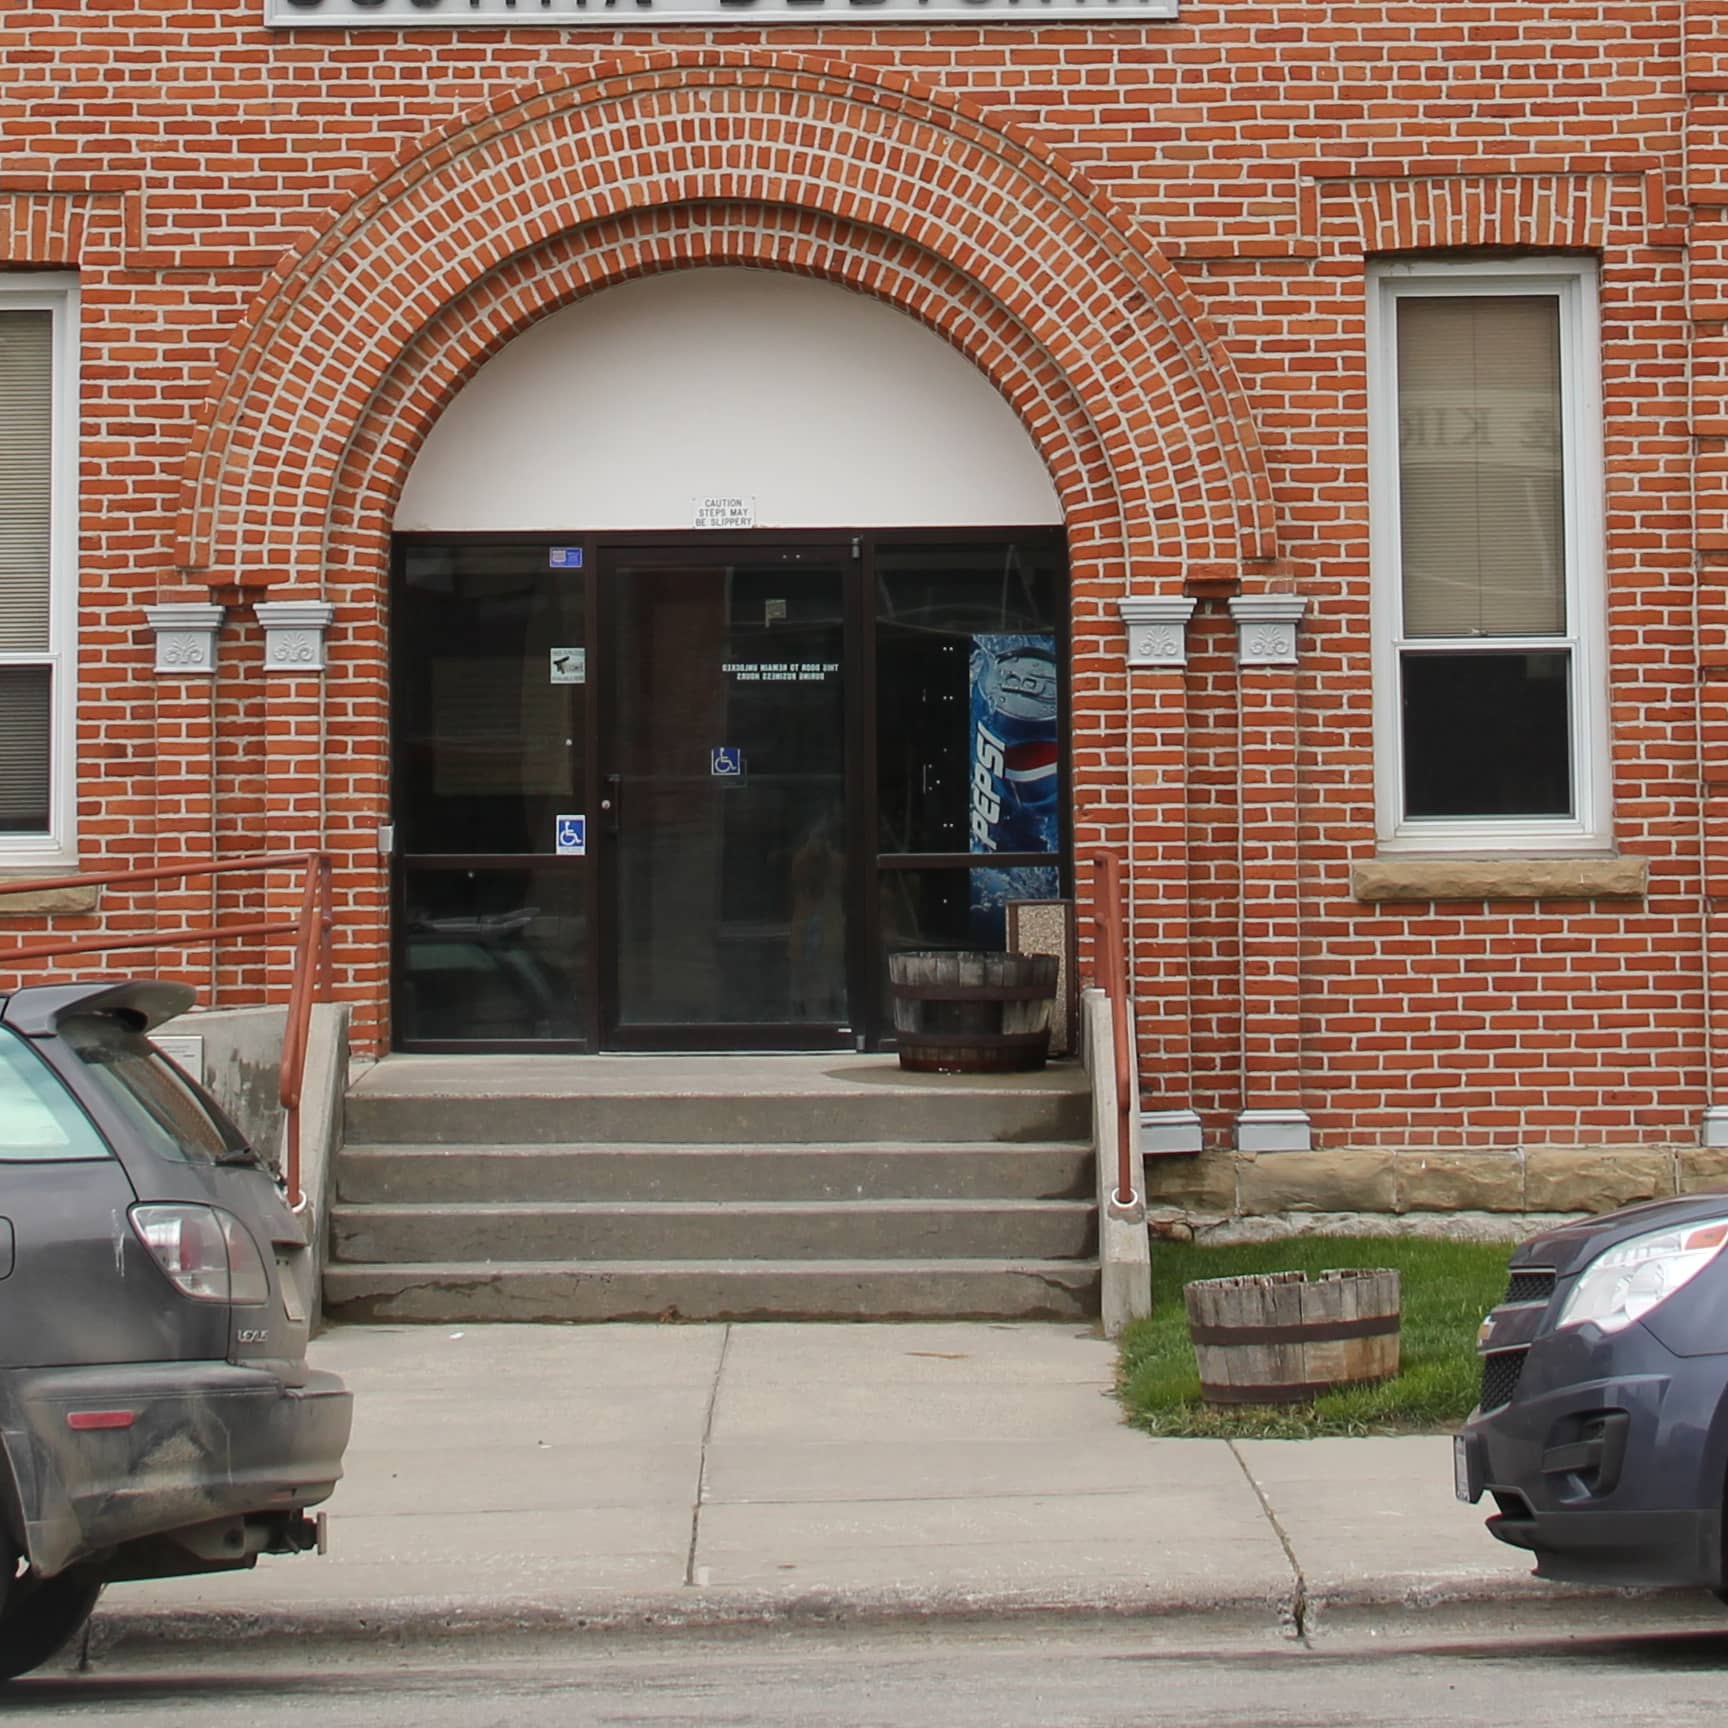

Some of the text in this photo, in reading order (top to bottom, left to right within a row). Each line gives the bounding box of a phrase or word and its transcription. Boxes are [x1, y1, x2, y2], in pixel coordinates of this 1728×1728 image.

[705, 498, 742, 507] CAUTION
[699, 508, 748, 517] STEPS MAY
[696, 517, 752, 527] BE SLIPPERY
[972, 720, 1006, 851] PEPSI
